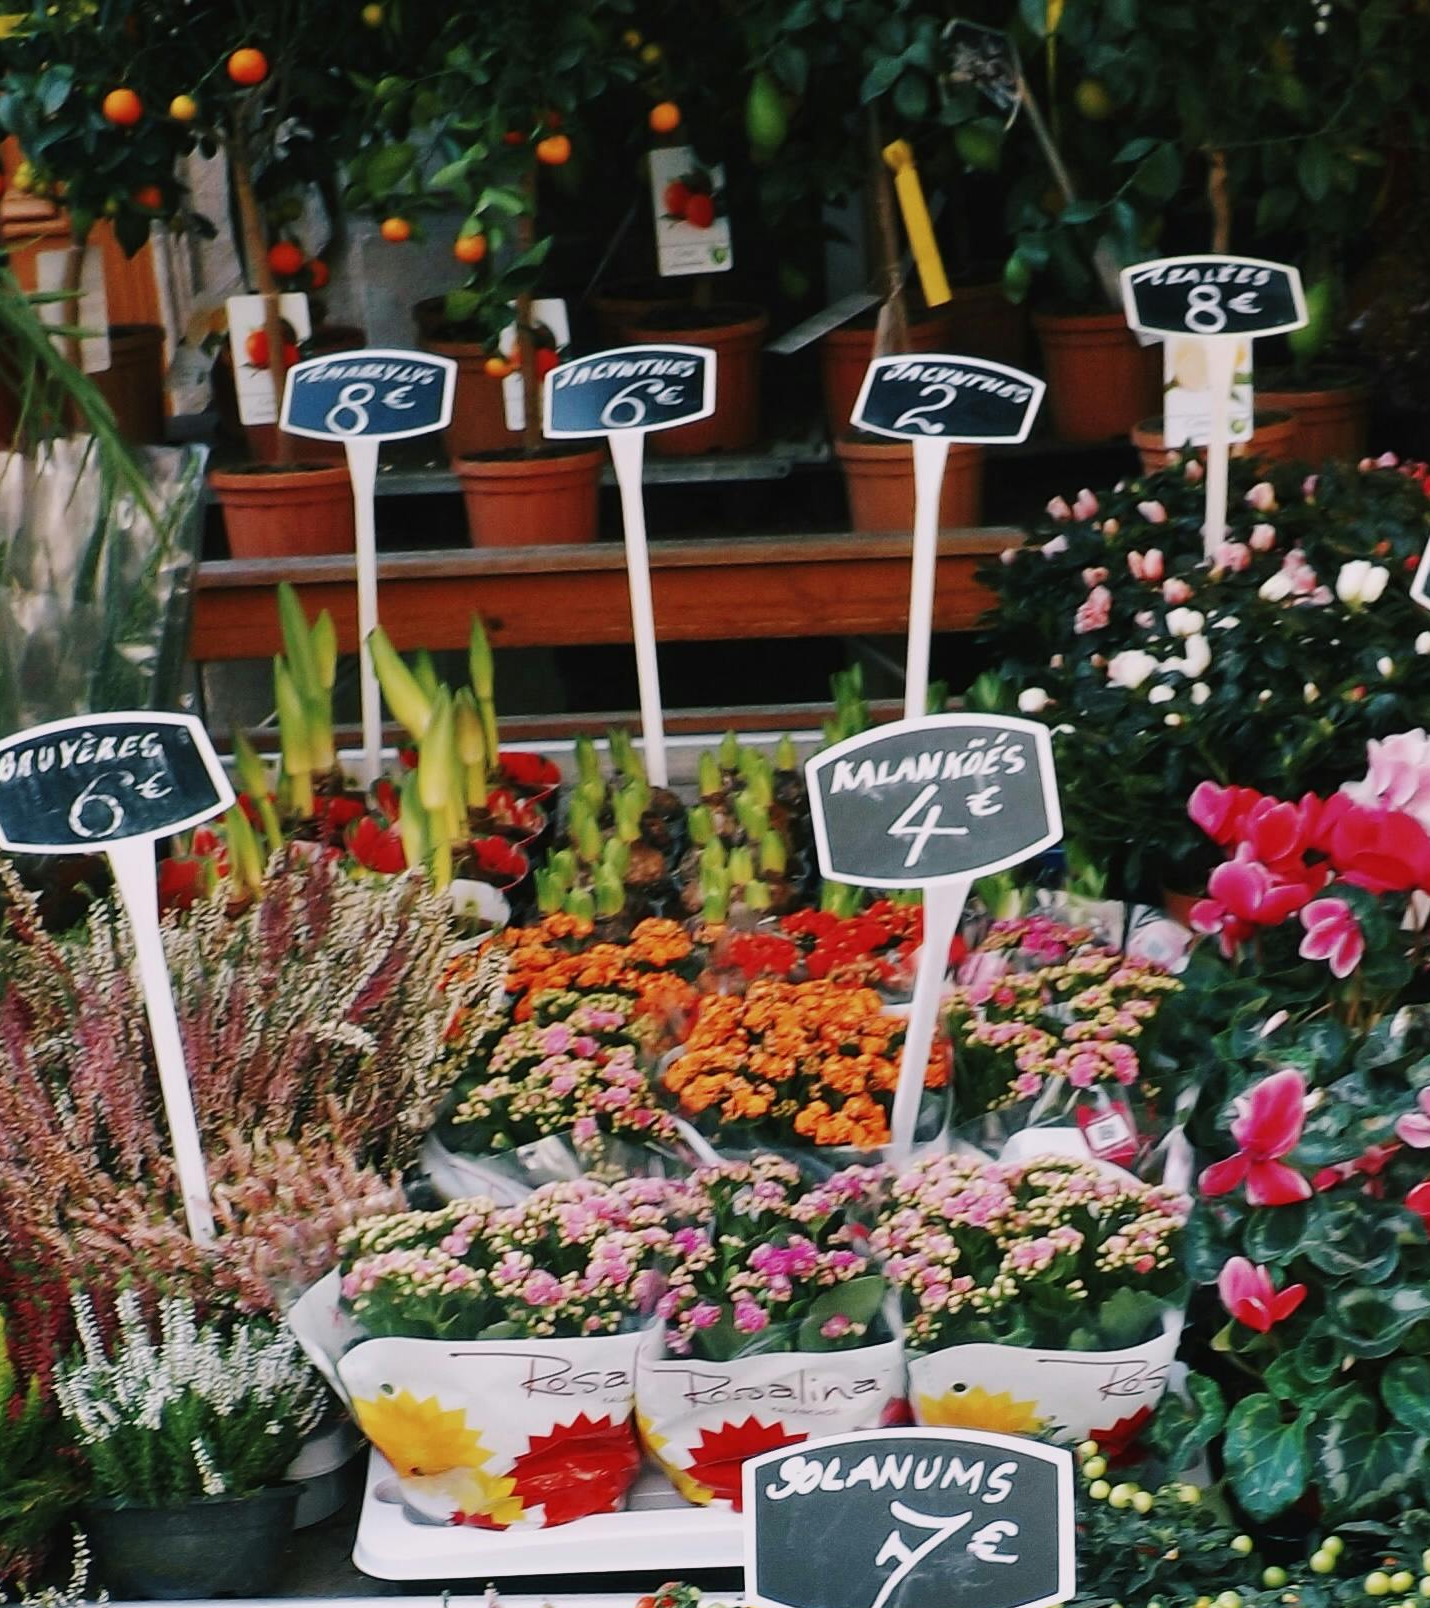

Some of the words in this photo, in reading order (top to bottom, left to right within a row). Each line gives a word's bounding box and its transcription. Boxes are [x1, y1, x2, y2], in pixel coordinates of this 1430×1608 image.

[892, 384, 957, 434] 2
[653, 1369, 881, 1407] Rosalina
[766, 1454, 1018, 1504] SOLANUMS
